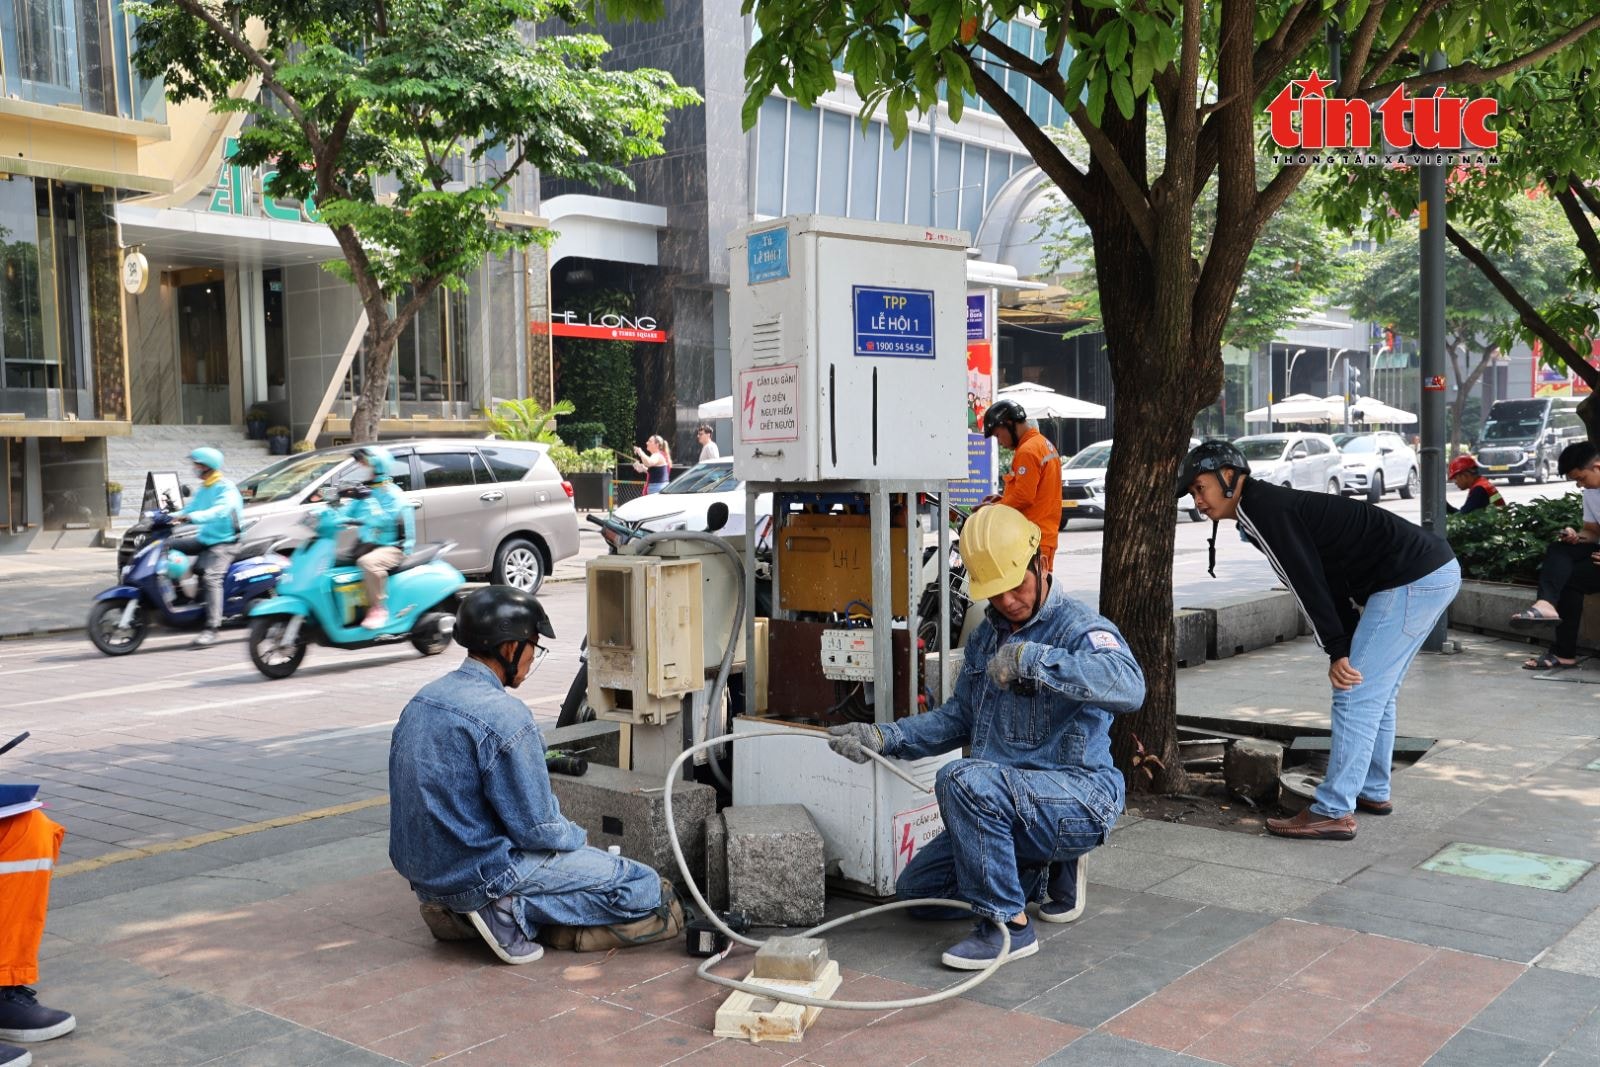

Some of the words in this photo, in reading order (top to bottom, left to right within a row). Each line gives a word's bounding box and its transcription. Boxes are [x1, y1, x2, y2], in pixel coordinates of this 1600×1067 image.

[883, 295, 907, 310] TPP
[589, 312, 657, 331] LONG
[871, 311, 886, 330] LỄ
[888, 315, 910, 334] HỘI
[913, 319, 919, 331] 1
[637, 331, 658, 339] SQUARE
[876, 342, 894, 351] 1900
[895, 342, 904, 351] 54
[905, 343, 914, 352] 54
[915, 343, 924, 352] 54
[761, 408, 777, 417] NGUY
[775, 419, 795, 429] NGƯỜI
